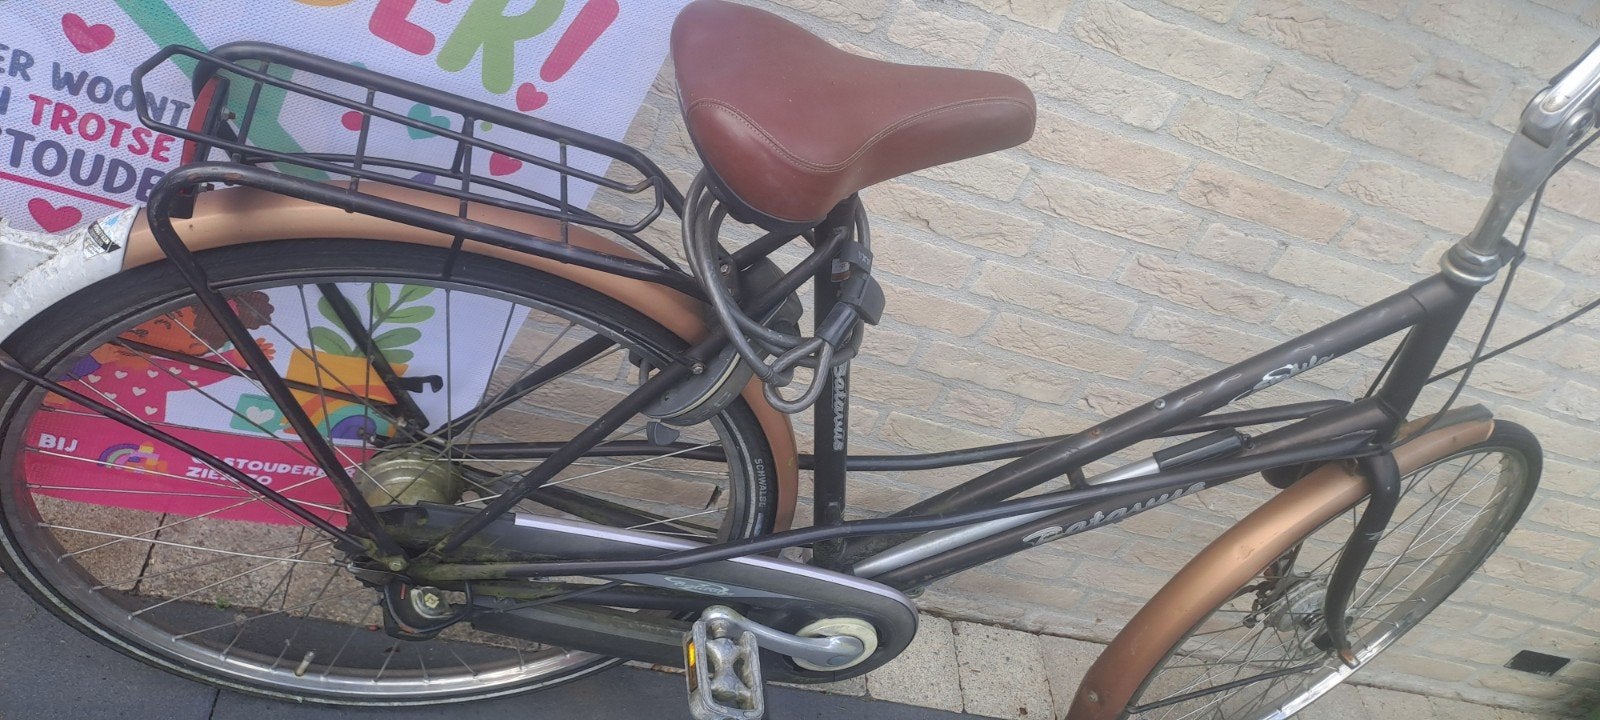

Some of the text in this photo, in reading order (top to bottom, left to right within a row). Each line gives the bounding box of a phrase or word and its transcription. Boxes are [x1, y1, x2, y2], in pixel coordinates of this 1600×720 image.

[51, 62, 191, 127] WOONT
[28, 93, 176, 163] TROTSE
[0, 128, 166, 202] TOUDE
[38, 433, 78, 452] BIJ
[754, 458, 767, 508] SCHWALBE
